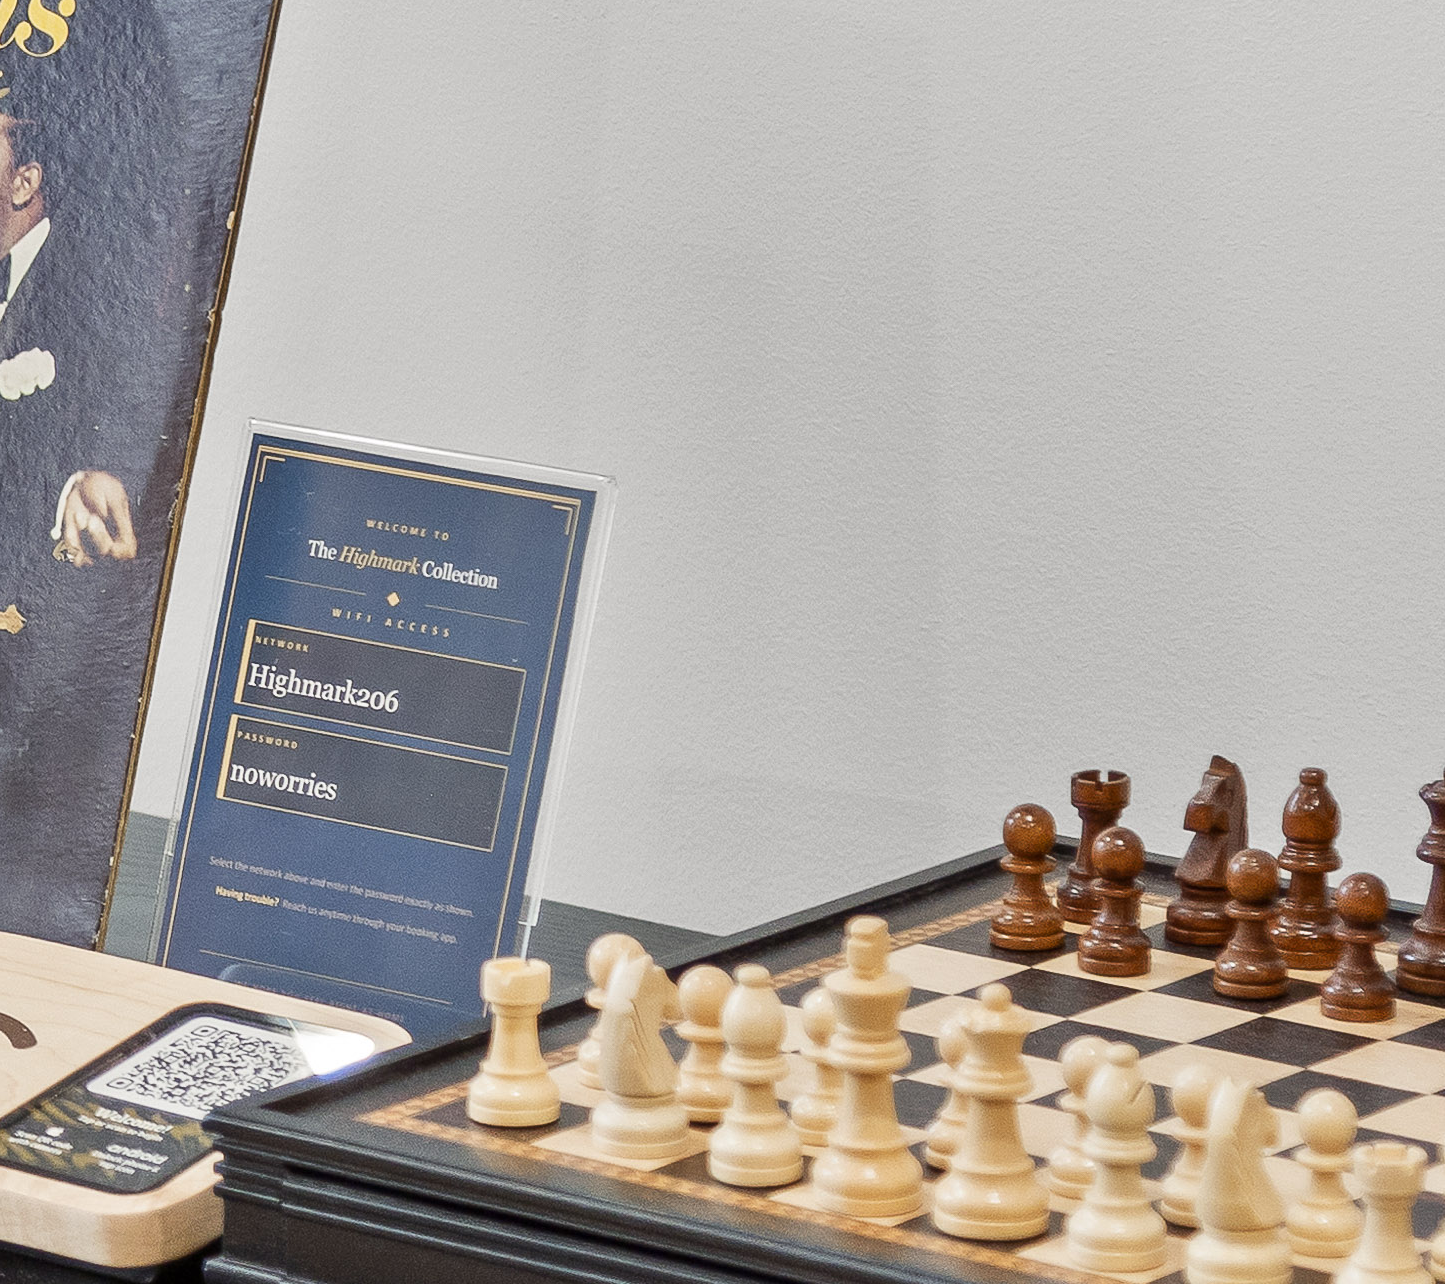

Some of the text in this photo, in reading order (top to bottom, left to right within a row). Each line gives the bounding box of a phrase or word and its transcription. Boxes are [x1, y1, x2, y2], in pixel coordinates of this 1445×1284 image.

[366, 519, 450, 541] WELCOME TO
[309, 539, 499, 590] The Highmark Collection
[331, 608, 451, 638] WIFI ACCESS
[254, 635, 310, 653] NETWORK
[247, 662, 400, 713] Highmark206
[236, 730, 299, 750] PASSWORD
[229, 763, 338, 801] noworries
[209, 855, 233, 870] Select
[235, 860, 248, 873] the
[249, 865, 282, 880] network
[283, 870, 308, 884] above
[309, 876, 326, 888] and
[350, 883, 364, 896] the
[364, 887, 404, 905] password
[404, 895, 434, 911] exactly
[215, 884, 244, 902] Having
[244, 890, 280, 907] trouble?
[282, 899, 307, 914] Reach
[308, 906, 318, 916] us
[318, 907, 352, 923] anytime
[352, 915, 386, 930] through
[385, 922, 406, 934] your
[406, 924, 439, 942] booking
